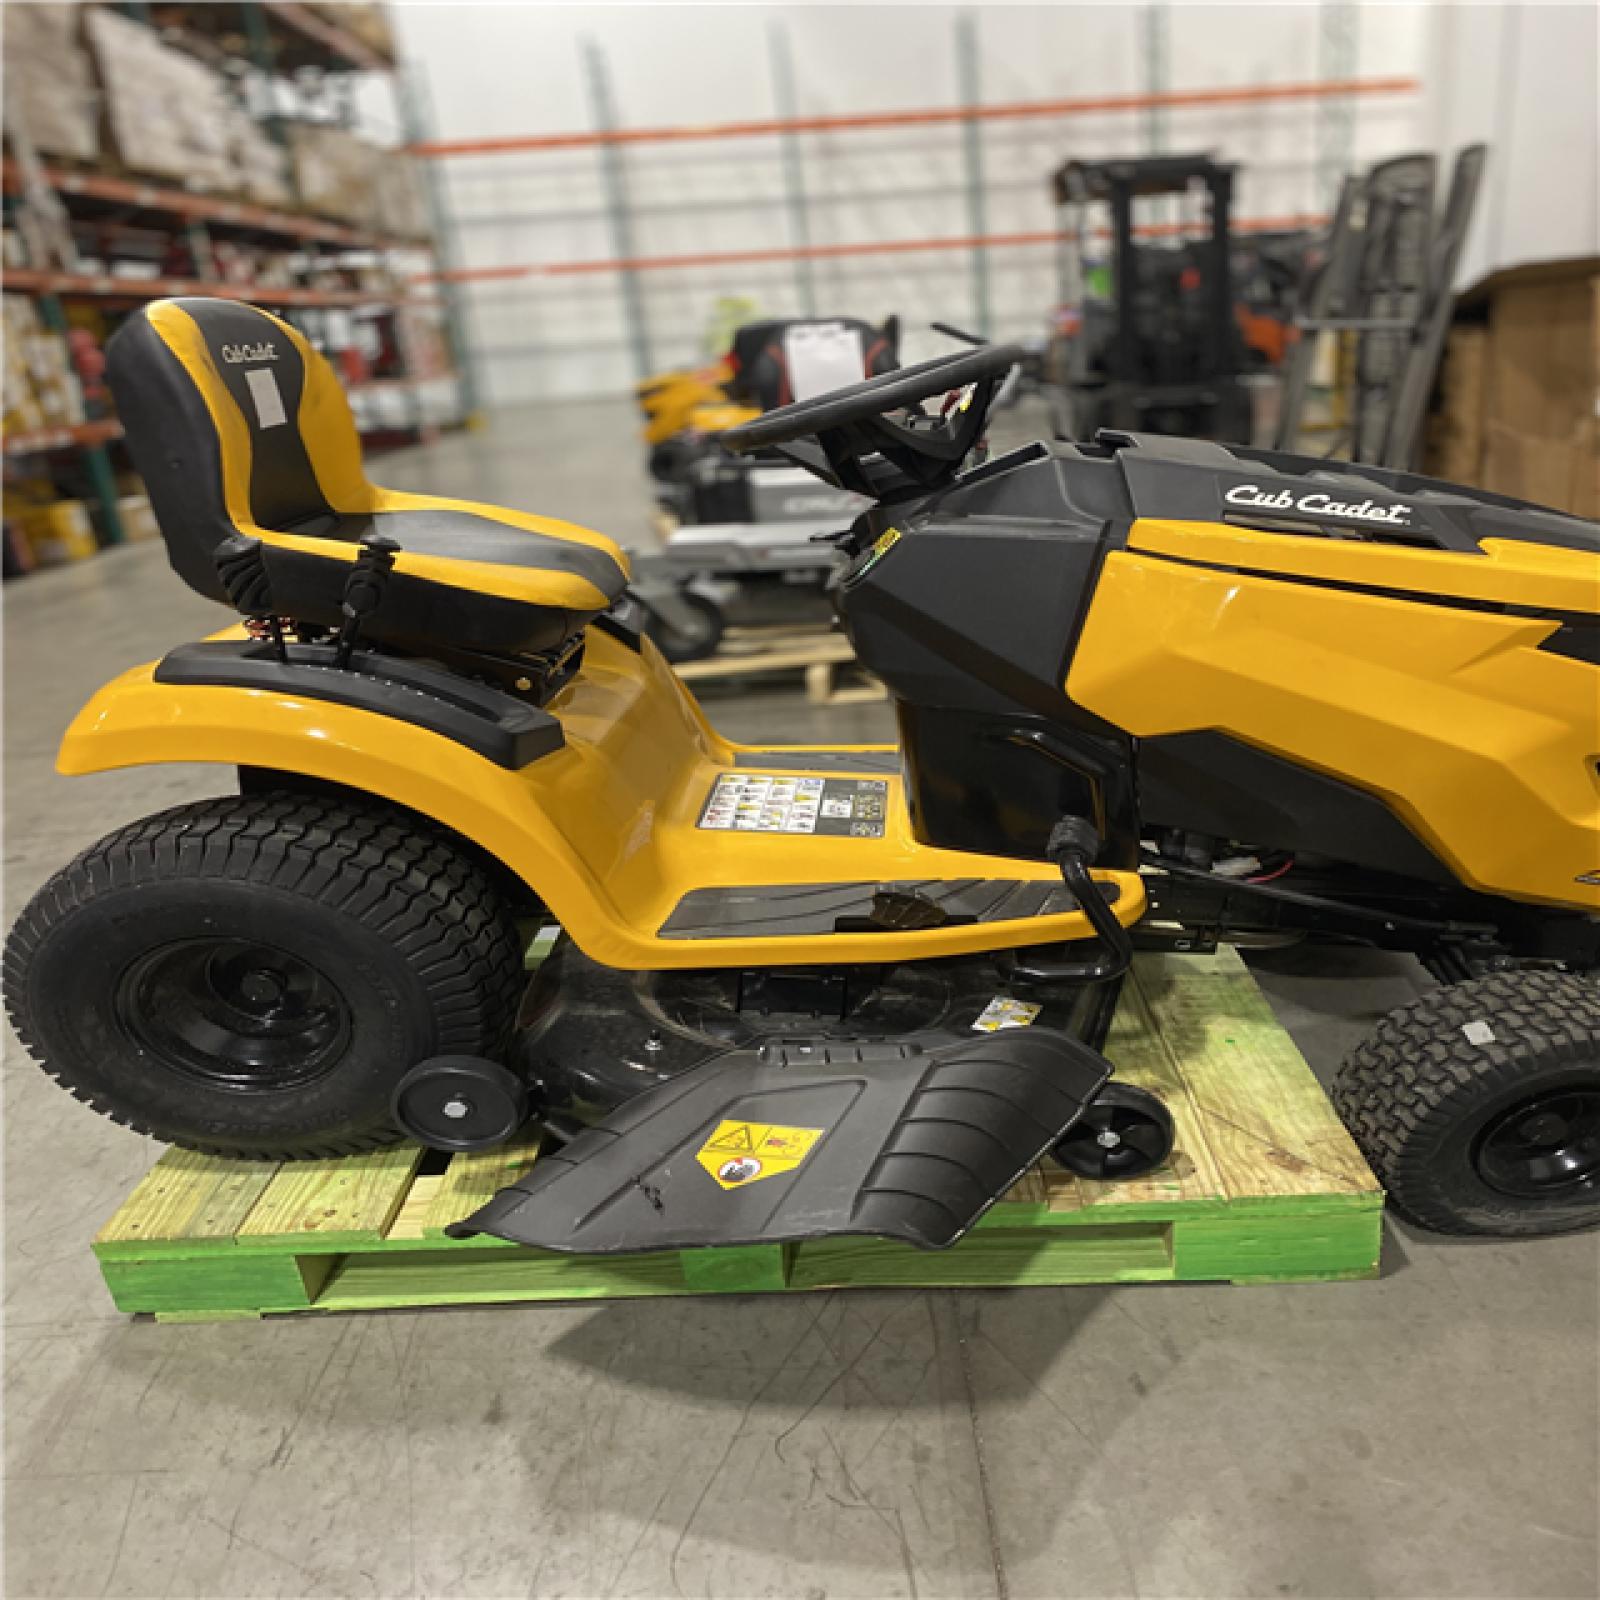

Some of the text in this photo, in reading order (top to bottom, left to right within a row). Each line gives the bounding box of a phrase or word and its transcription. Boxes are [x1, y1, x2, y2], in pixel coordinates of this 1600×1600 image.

[222, 344, 243, 363] Cub
[1225, 485, 1411, 523] Cub Cadet
